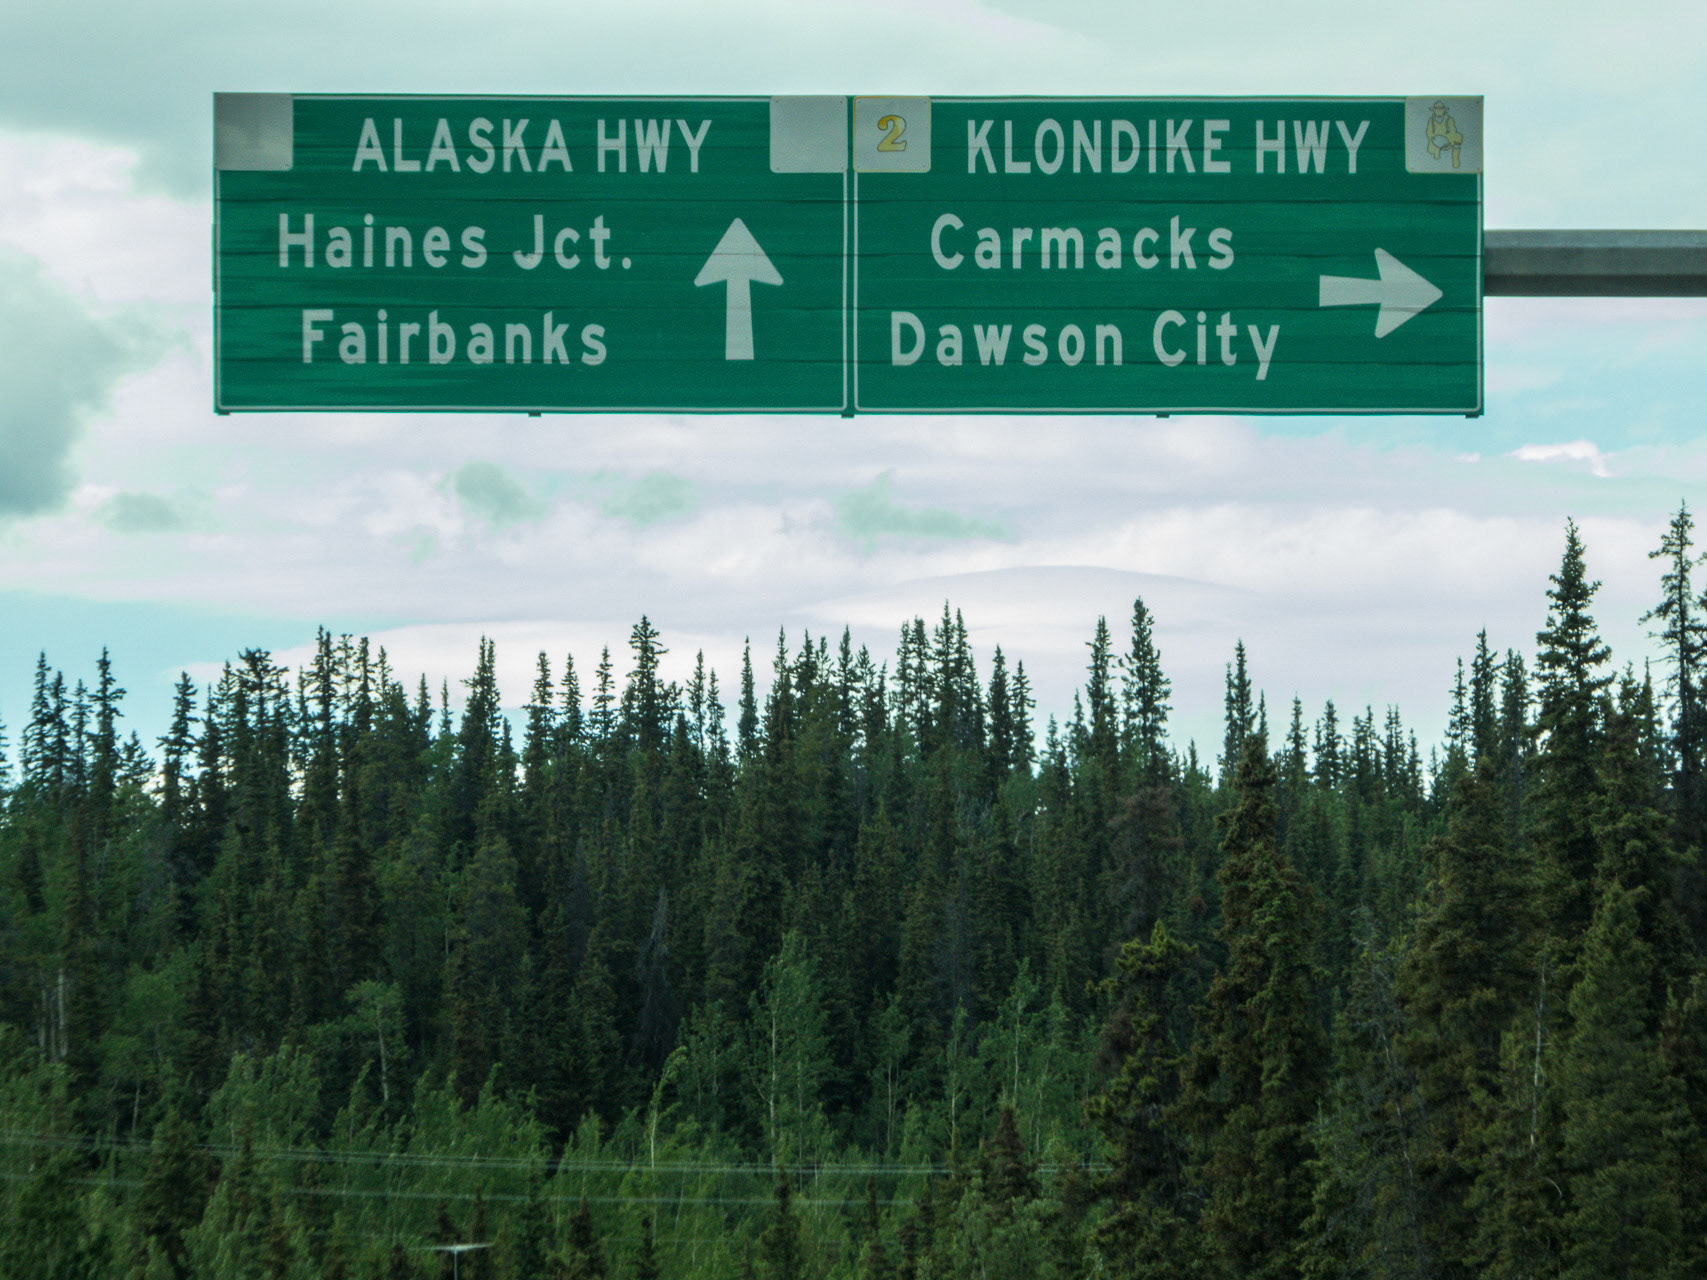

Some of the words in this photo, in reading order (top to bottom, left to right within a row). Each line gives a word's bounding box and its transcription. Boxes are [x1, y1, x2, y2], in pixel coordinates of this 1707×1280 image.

[353, 118, 573, 173] ALASKA
[597, 119, 711, 173] HWY
[877, 115, 908, 152] 2
[968, 119, 1231, 175] KLONDIKE
[1256, 119, 1370, 175] HWY
[279, 213, 487, 269] Haines
[514, 214, 632, 272] Jct.
[931, 213, 1234, 271] Carmacks
[301, 309, 607, 366] Fairbanks
[891, 311, 1123, 367] Dawson
[1152, 310, 1280, 381] City
